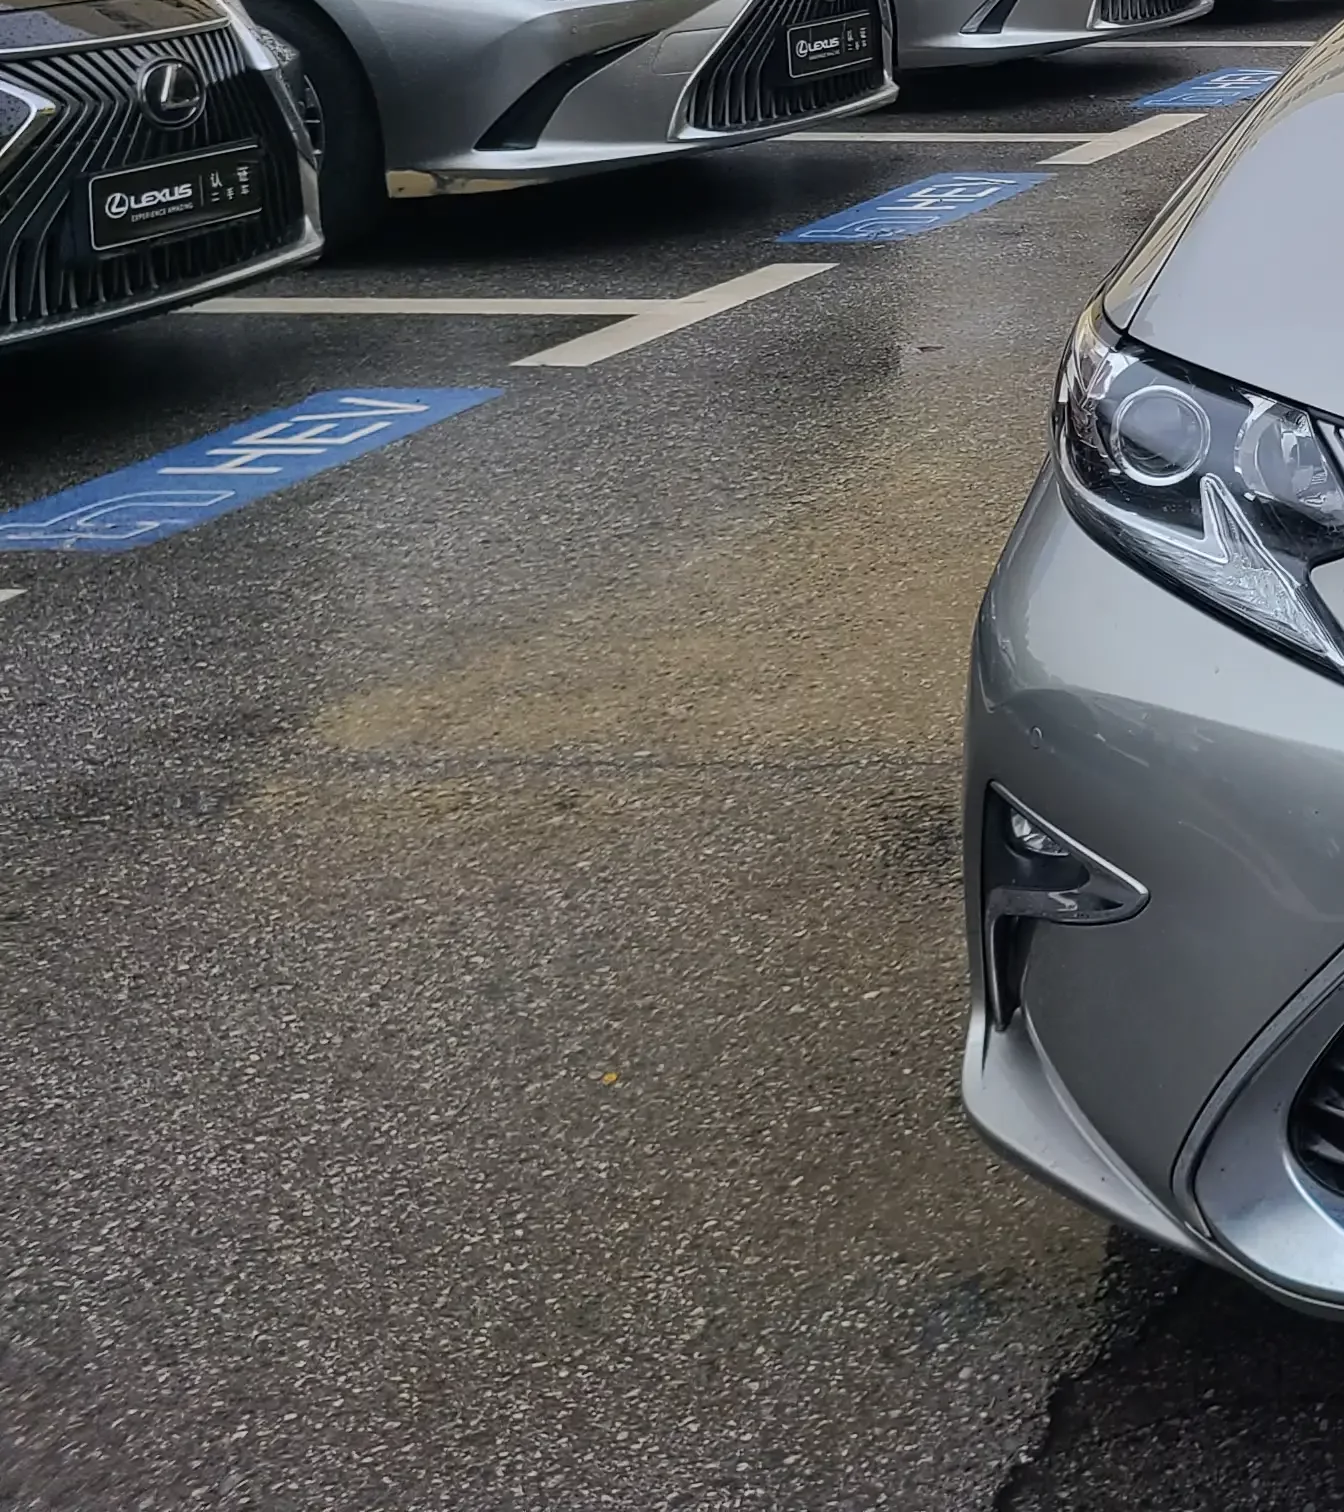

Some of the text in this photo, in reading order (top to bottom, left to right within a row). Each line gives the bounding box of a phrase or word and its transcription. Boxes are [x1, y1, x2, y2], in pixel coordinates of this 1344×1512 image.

[808, 37, 840, 53] LEXUS
[130, 183, 193, 209] LEXUS
[876, 176, 1019, 212] HEV
[156, 396, 431, 475] HEV
